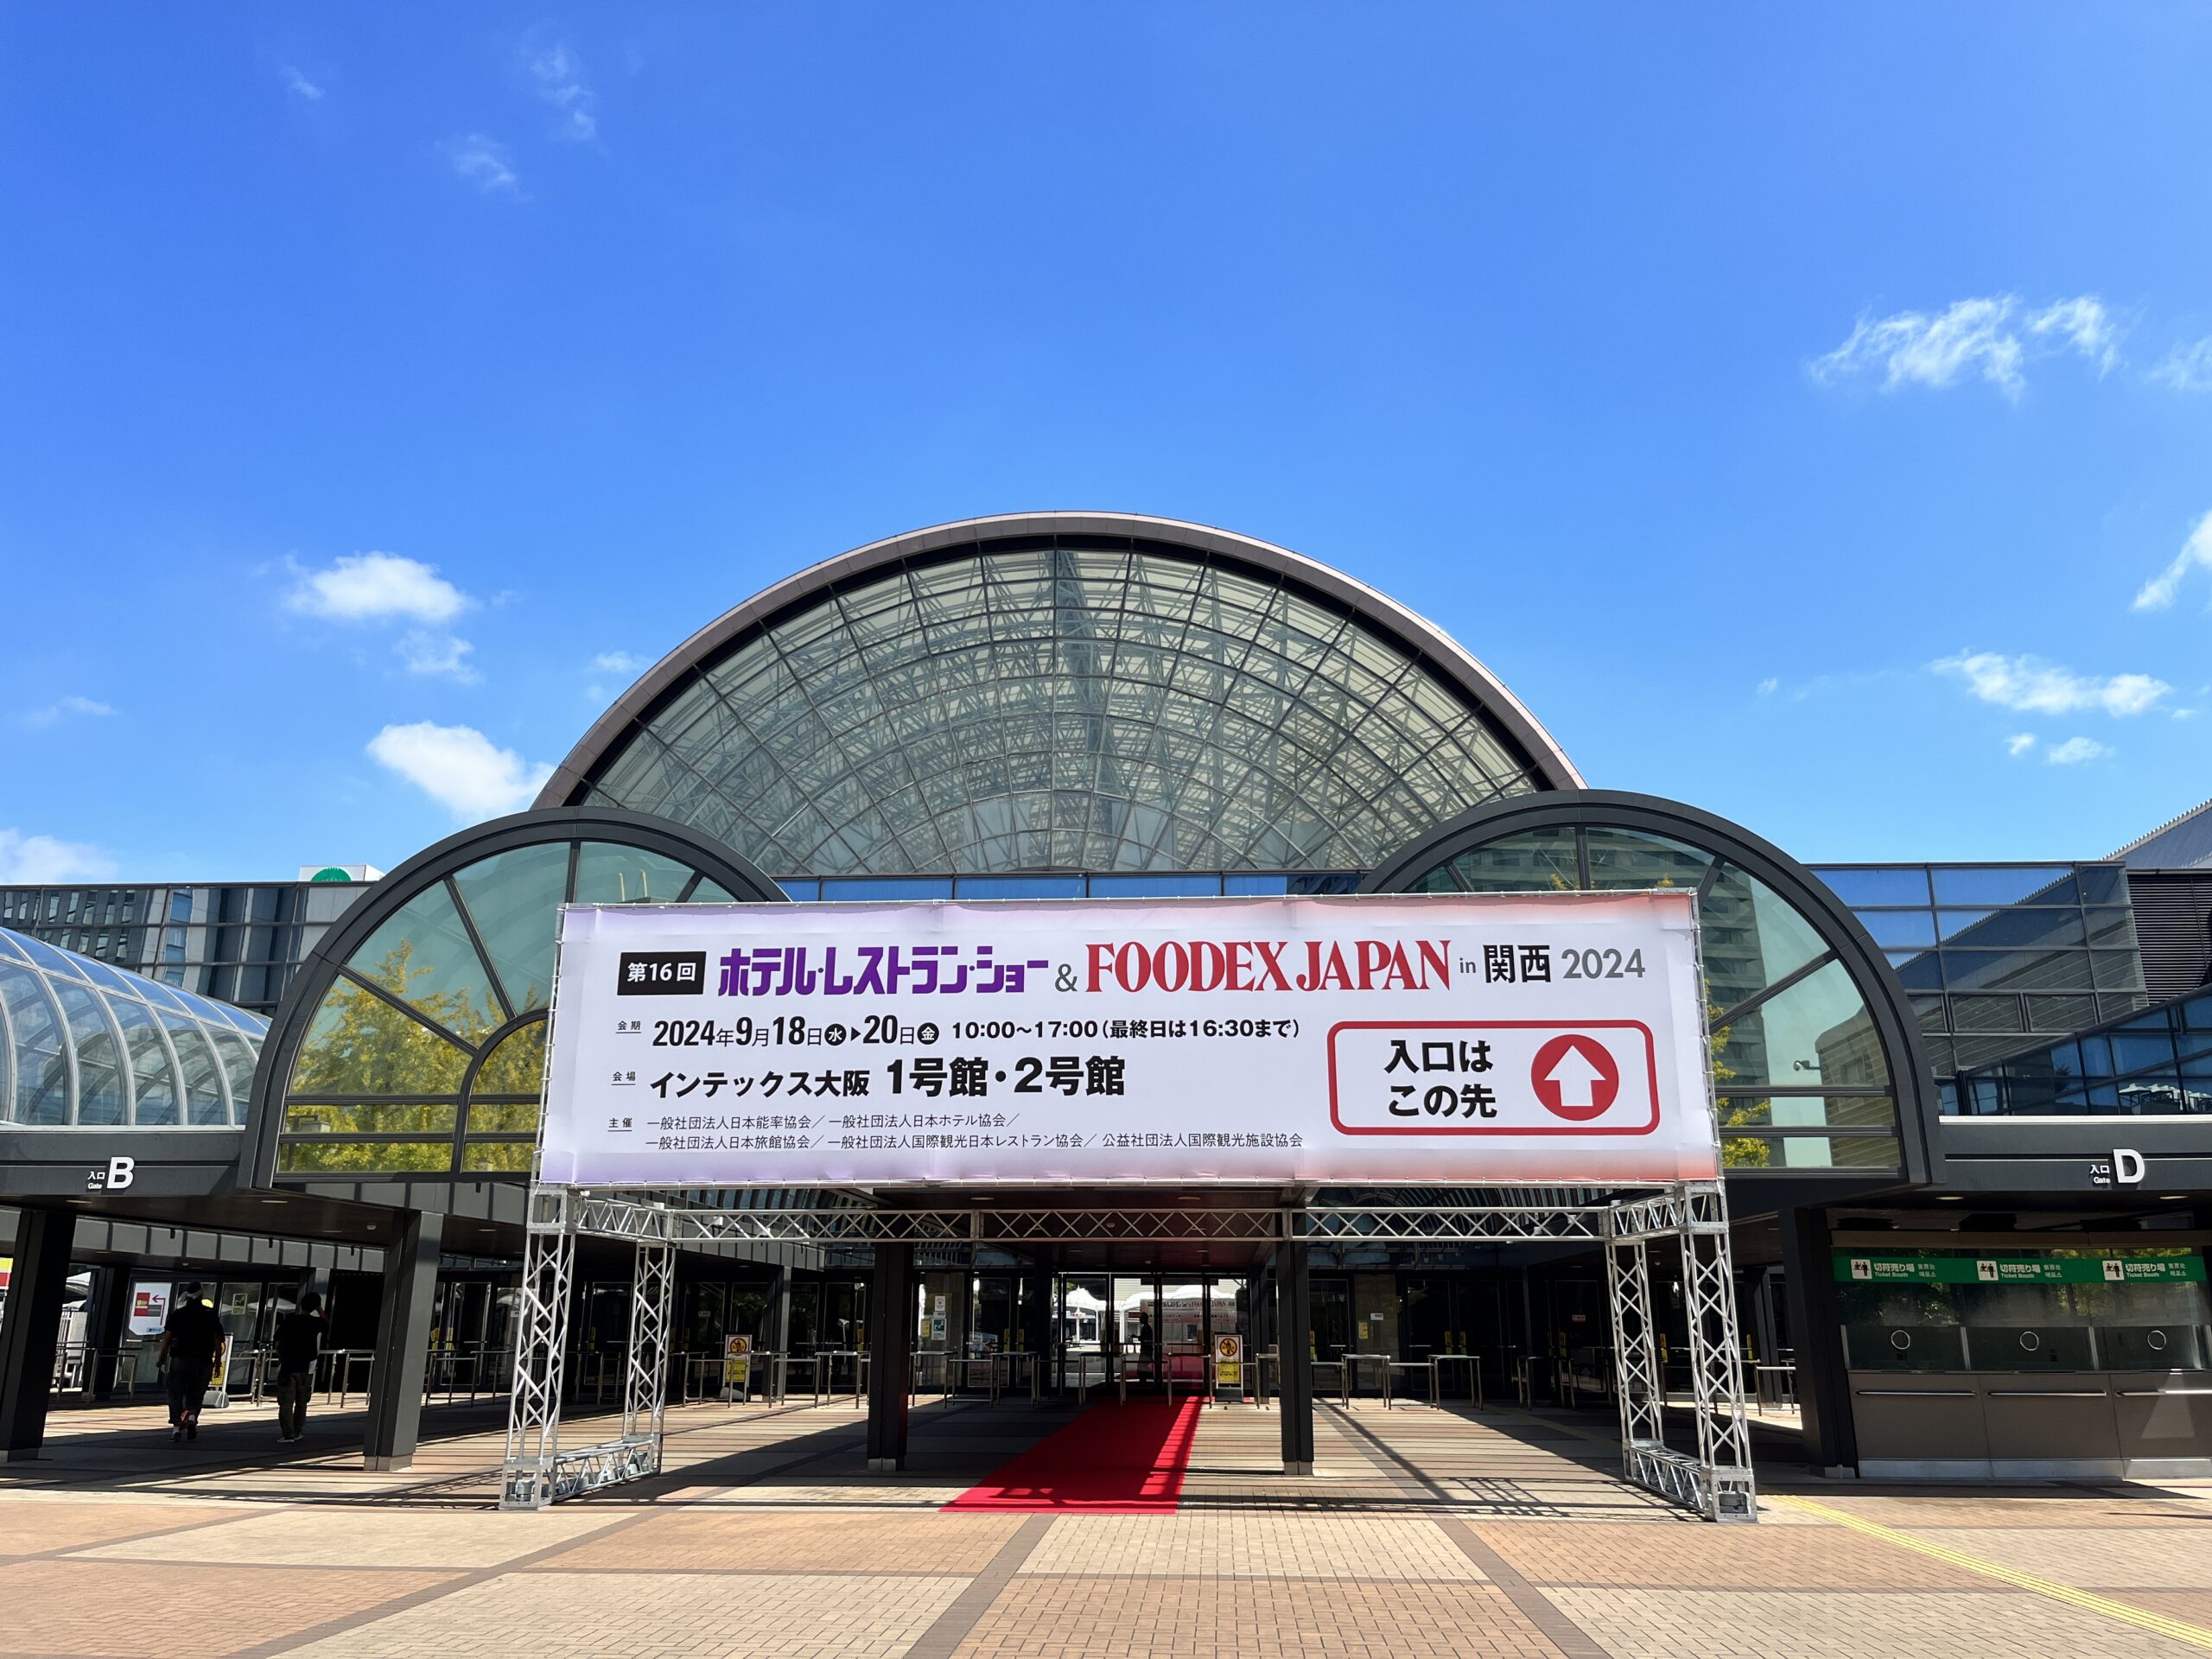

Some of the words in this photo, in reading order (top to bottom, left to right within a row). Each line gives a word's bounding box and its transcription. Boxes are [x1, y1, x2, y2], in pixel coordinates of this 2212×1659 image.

[626, 962, 696, 982] 第16回
[1055, 963, 1077, 992] &
[1085, 941, 1292, 992] FOODEX
[1296, 940, 1451, 991] JAPAN
[1459, 957, 1476, 973] in
[1483, 945, 1551, 983] 関西
[1561, 949, 1645, 979] 2024
[618, 1020, 640, 1030] 会期
[1383, 1040, 1493, 1074] 入口は
[613, 1071, 635, 1081] 会場
[650, 1070, 870, 1098] インテックス大阪
[887, 1056, 1125, 1097] 1号館・2号館
[1389, 1084, 1497, 1118] この先
[609, 1118, 632, 1128] 主催
[87, 1171, 105, 1180] 入口
[106, 1156, 134, 1189] B
[2089, 1164, 2110, 1174] 入口
[2113, 1148, 2145, 1184] D
